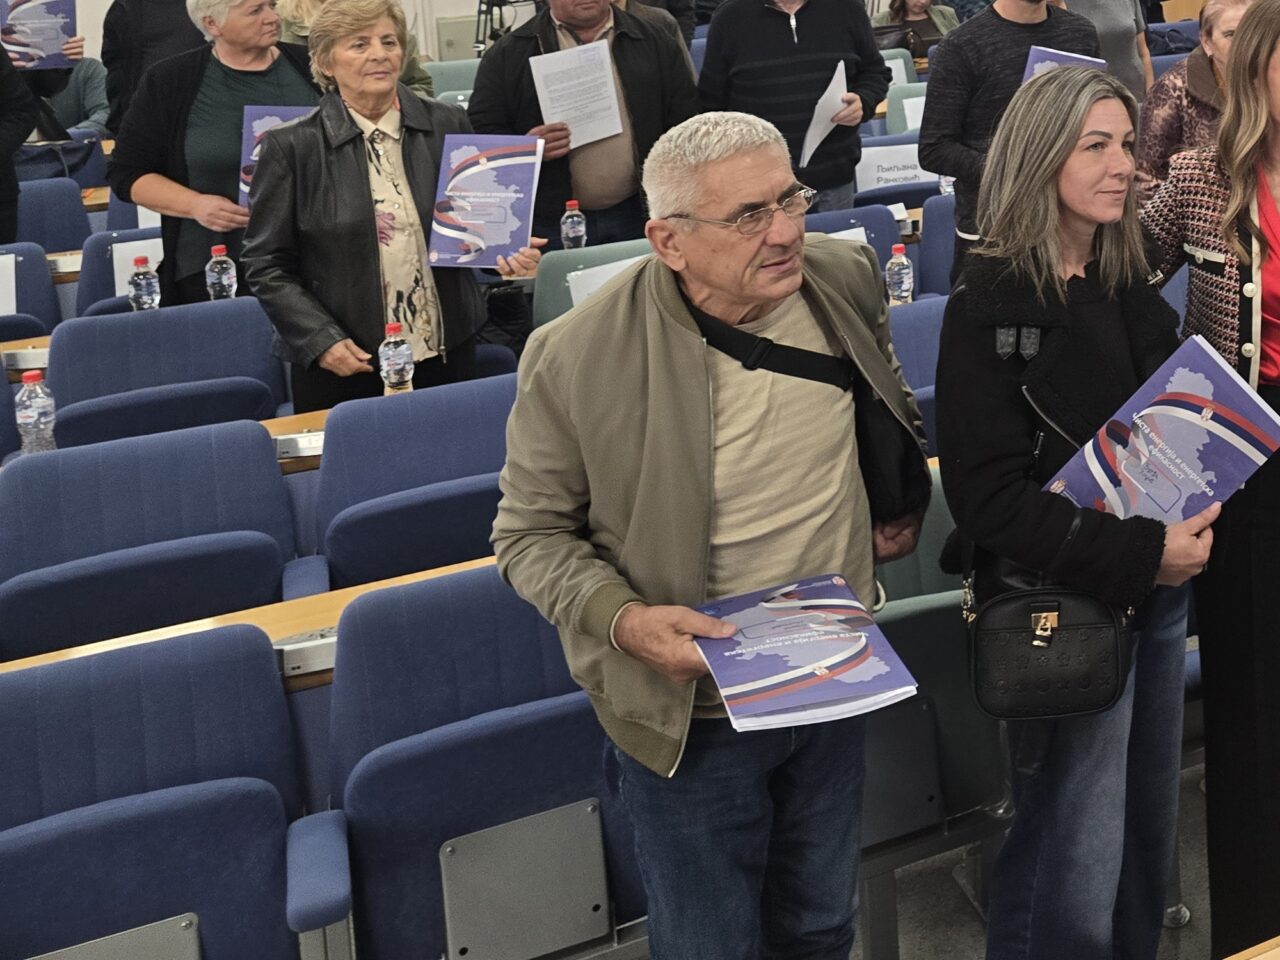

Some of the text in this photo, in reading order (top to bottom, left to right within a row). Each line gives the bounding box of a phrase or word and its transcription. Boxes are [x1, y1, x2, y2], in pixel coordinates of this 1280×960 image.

[877, 164, 918, 173] Љиљана
[877, 174, 920, 184] Ранковић
[1132, 412, 1151, 434] Чиста
[1148, 431, 1177, 459] енергија
[1180, 462, 1214, 497] енергетска
[1148, 444, 1185, 480] ефикасност
